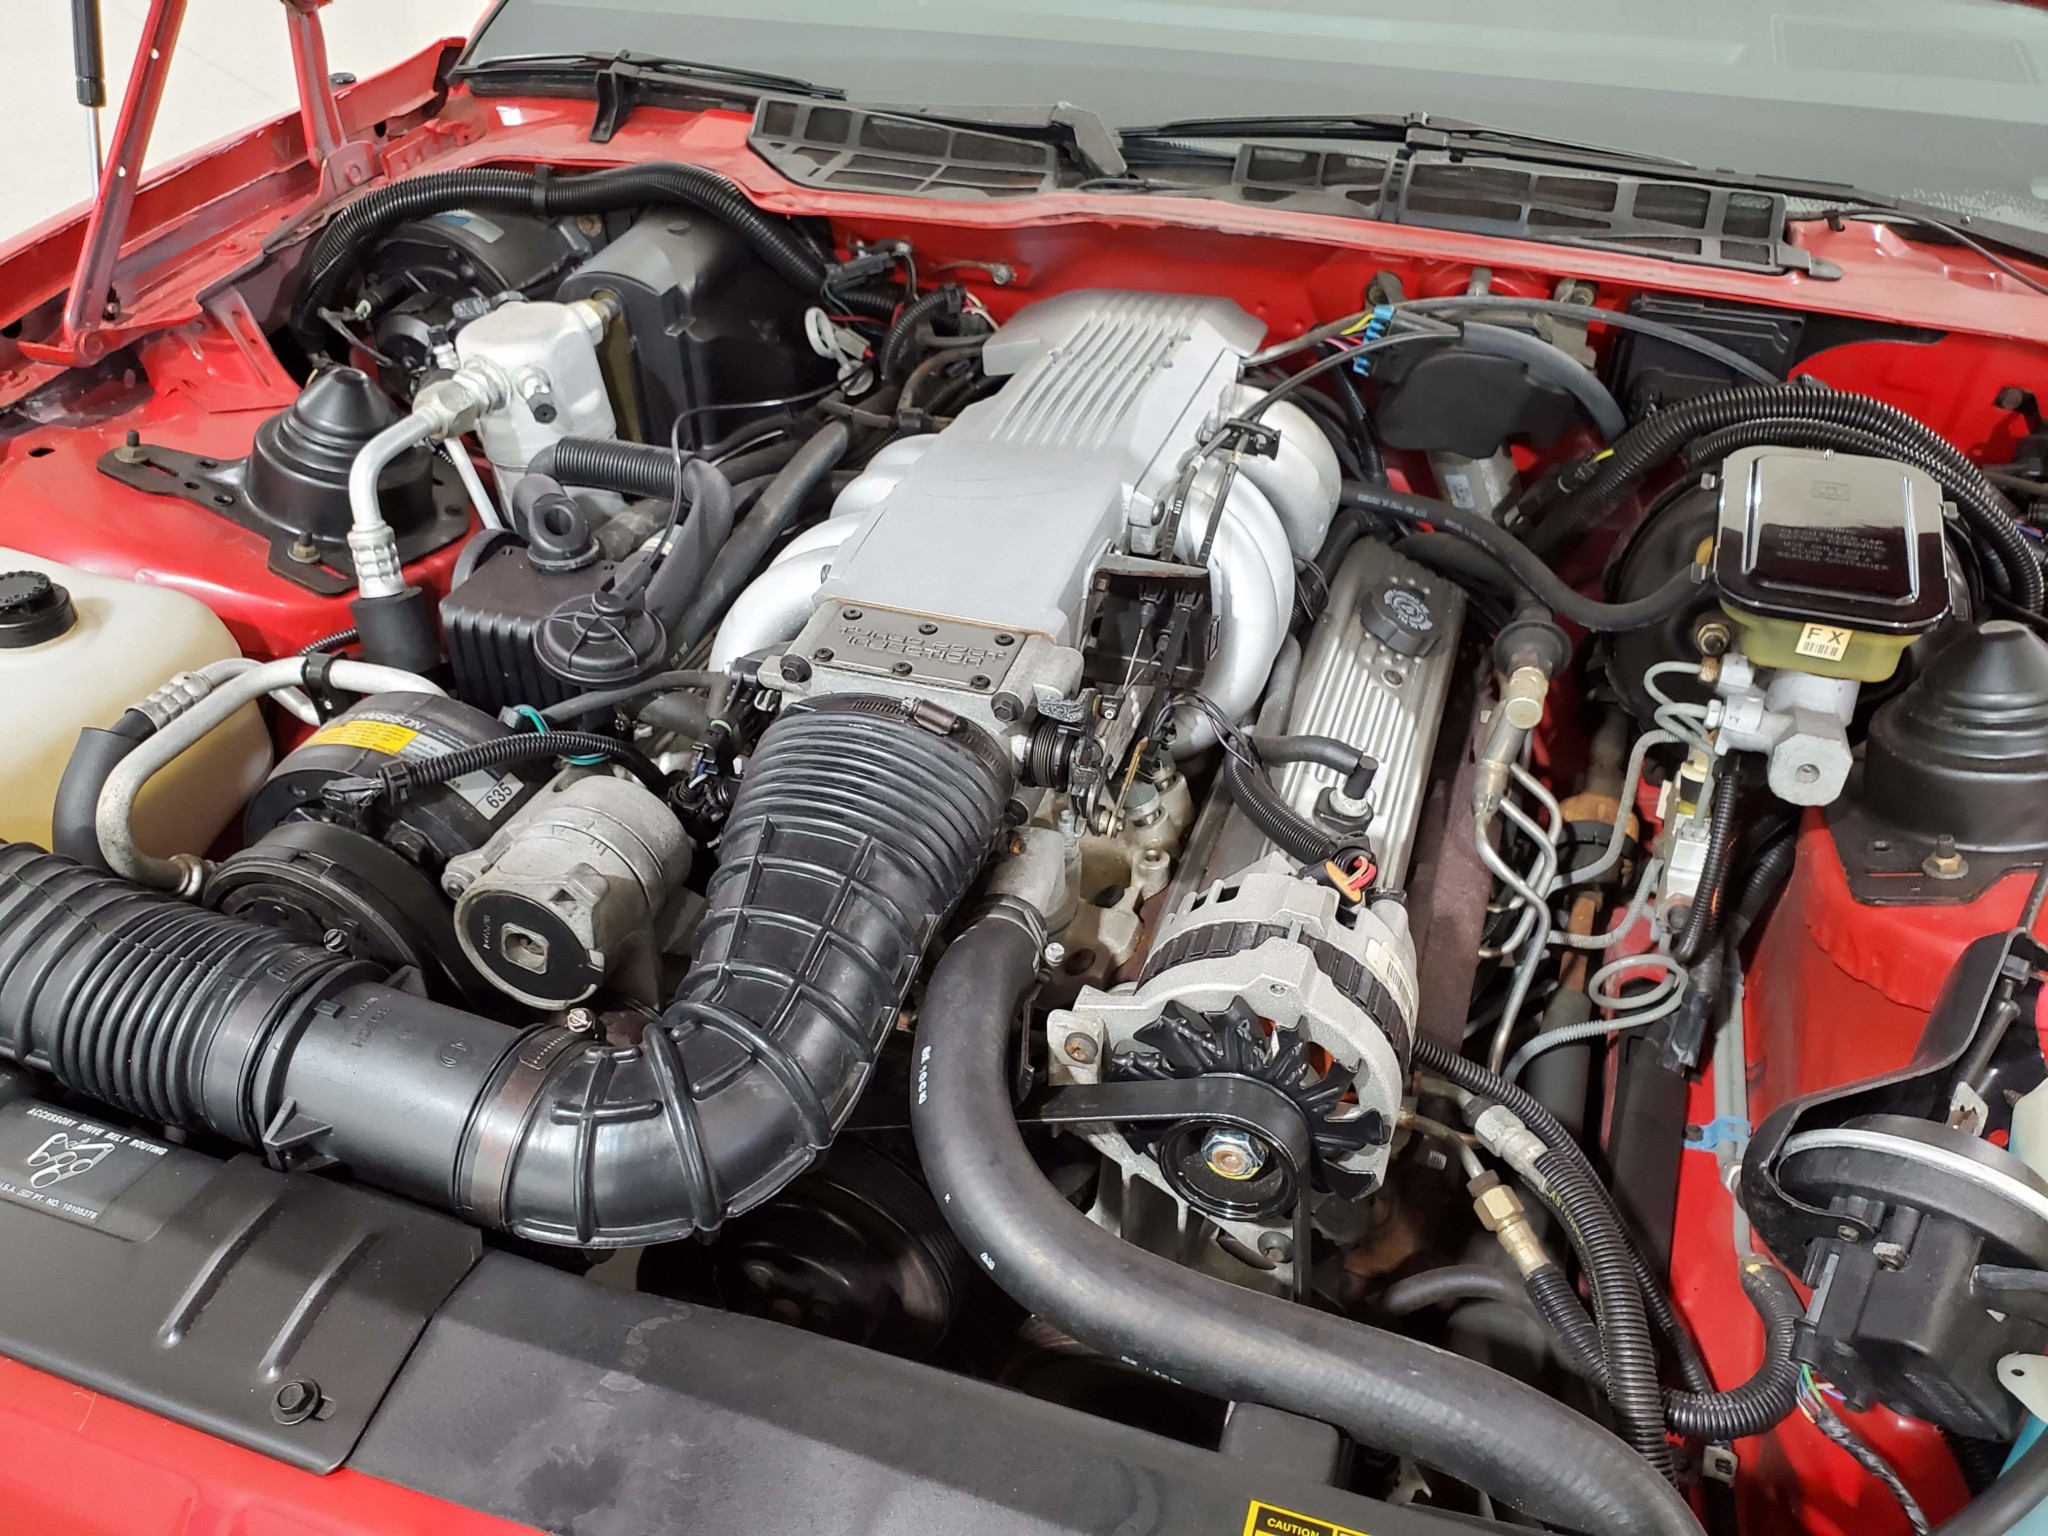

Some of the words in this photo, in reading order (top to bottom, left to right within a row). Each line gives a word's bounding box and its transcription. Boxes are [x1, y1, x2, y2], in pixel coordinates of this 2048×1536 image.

[848, 636, 984, 668] INJECTION
[355, 712, 427, 730] HARRISON
[486, 782, 513, 808] 635
[26, 1107, 78, 1127] ACCESSORY
[77, 1123, 105, 1136] DRIVE
[104, 1131, 131, 1144] BELT
[129, 1137, 169, 1156] ROUTING
[32, 1192, 45, 1202] PT.
[47, 1198, 60, 1208] NO.
[62, 1203, 98, 1220] 10105278
[1266, 1517, 1320, 1536] CAUTION
